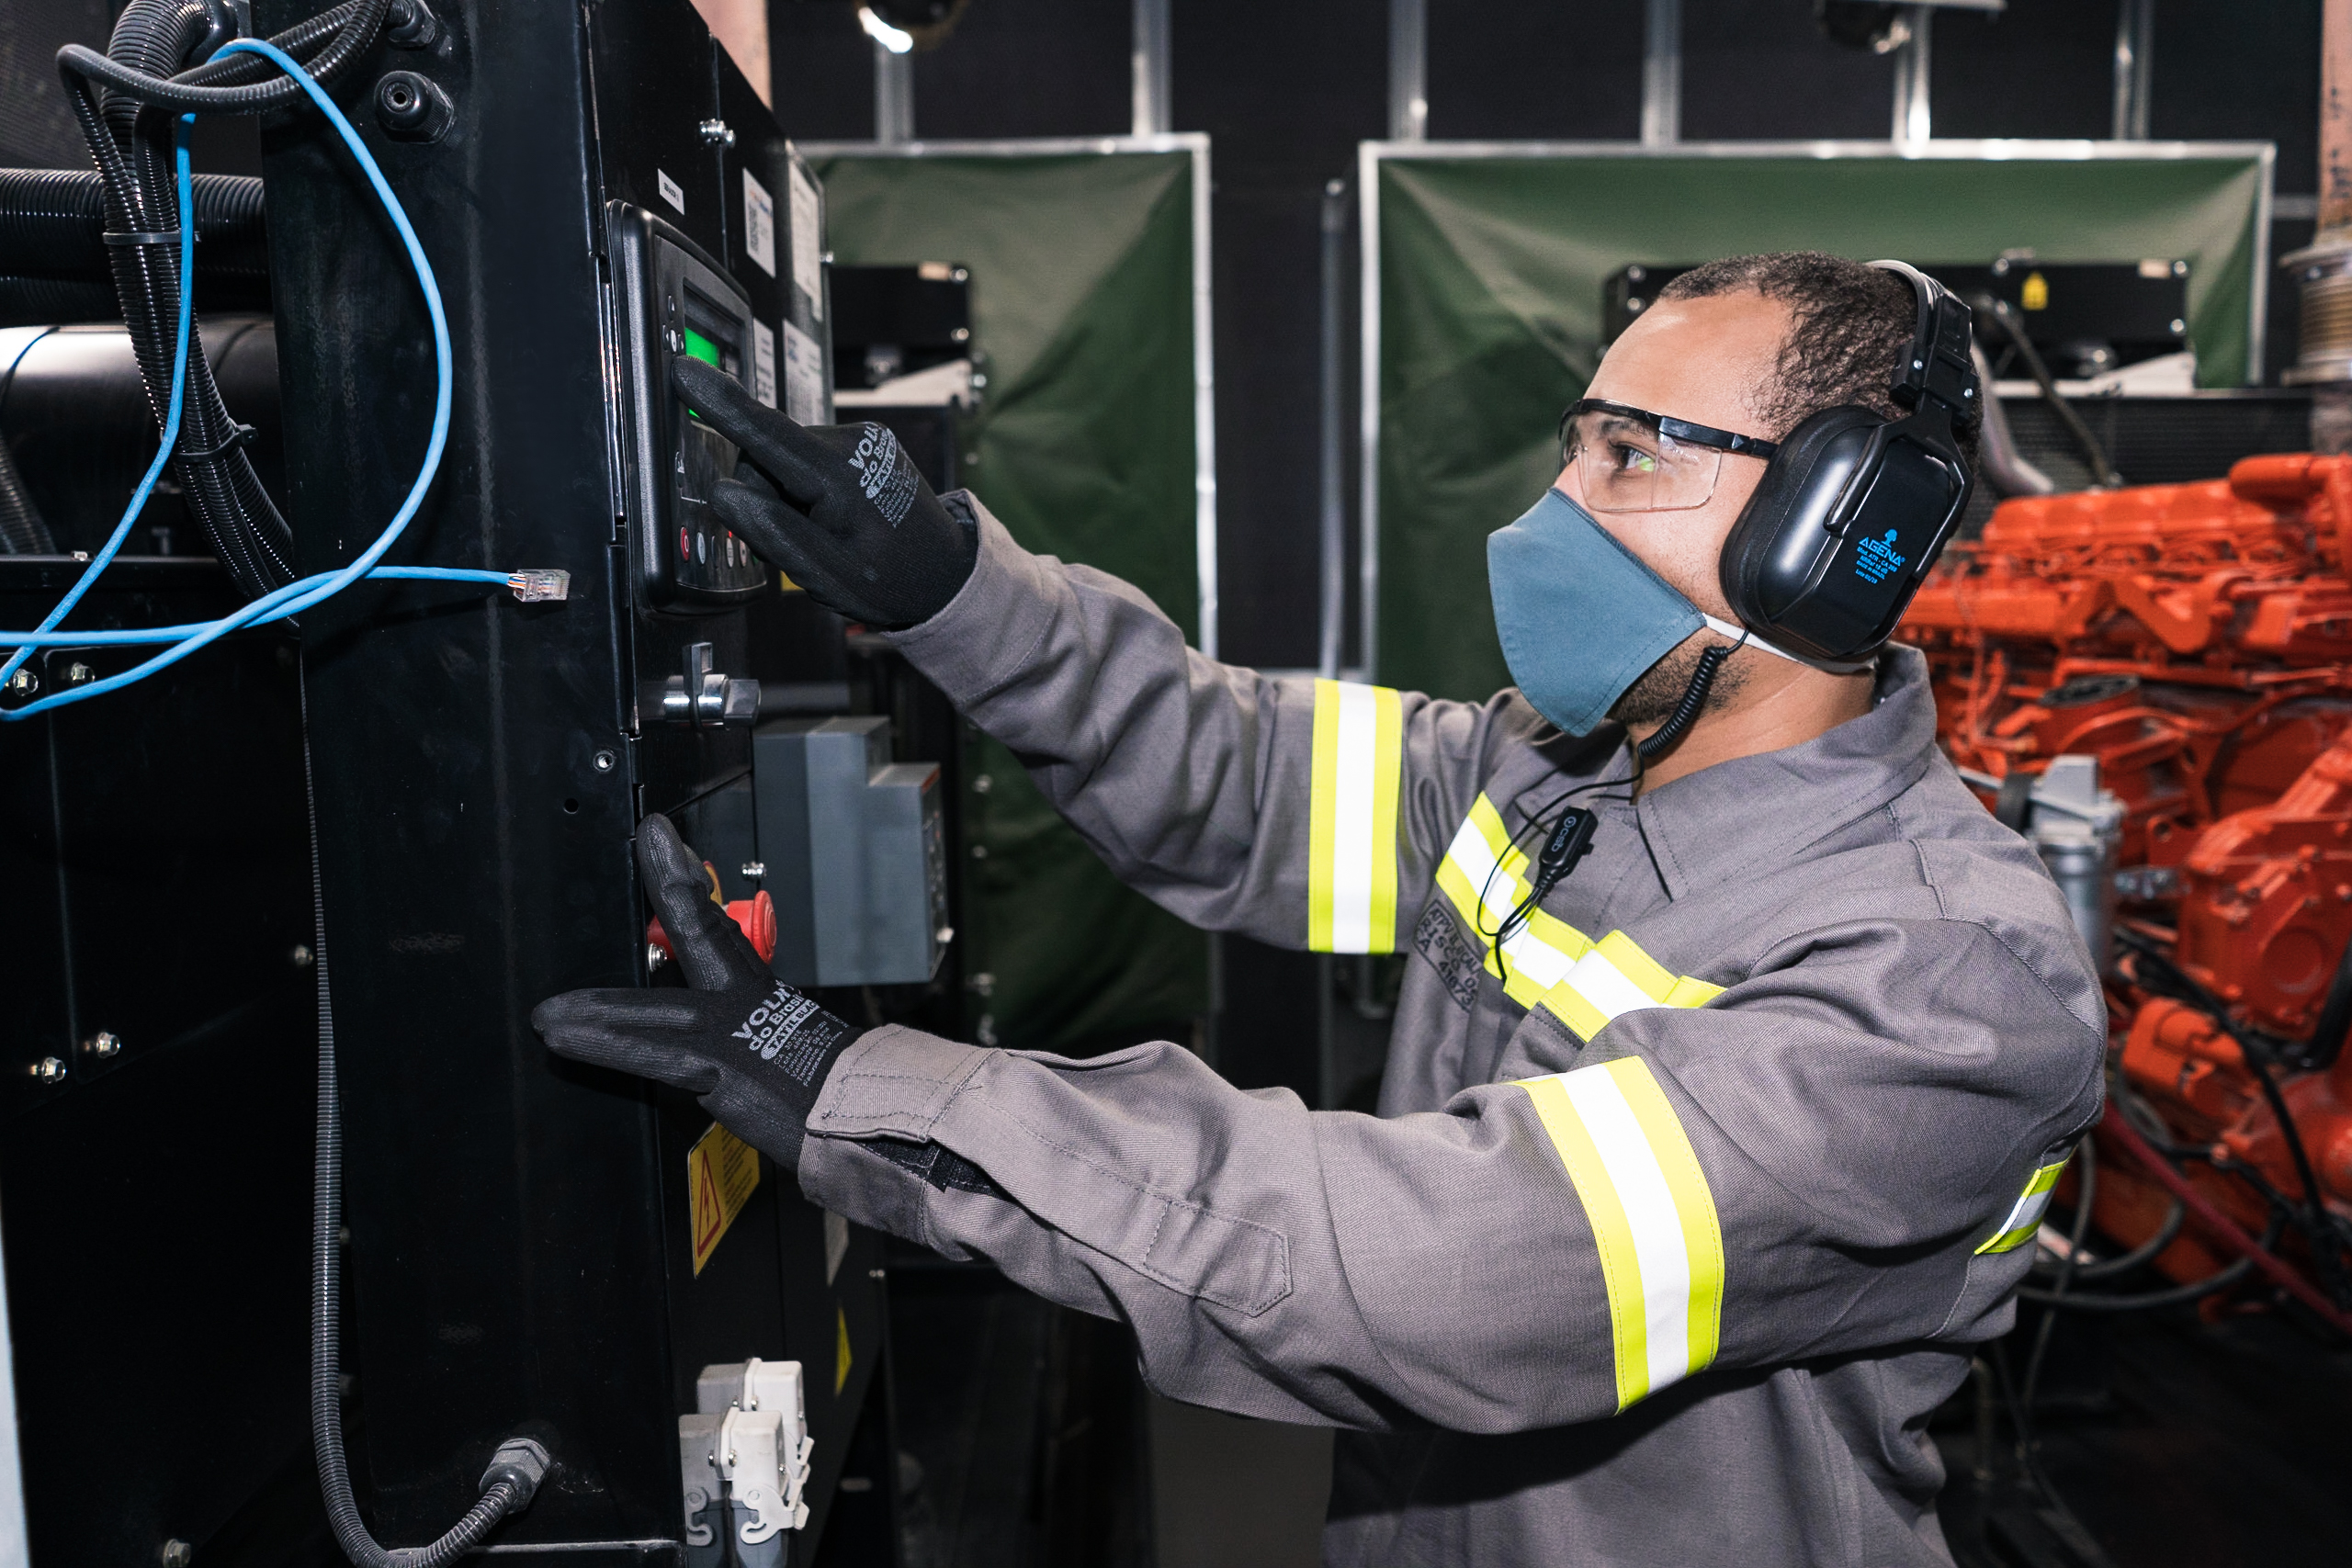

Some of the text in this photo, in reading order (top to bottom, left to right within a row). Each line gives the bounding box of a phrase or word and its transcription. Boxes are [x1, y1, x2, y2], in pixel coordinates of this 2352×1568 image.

[860, 460, 877, 488] do
[1859, 537, 1902, 566] AGENA
[1868, 553, 1879, 562] ATR
[1420, 919, 1461, 971] RISCO
[749, 994, 805, 1051] do Brasil
[768, 1000, 819, 1049] TATIL BLAC
